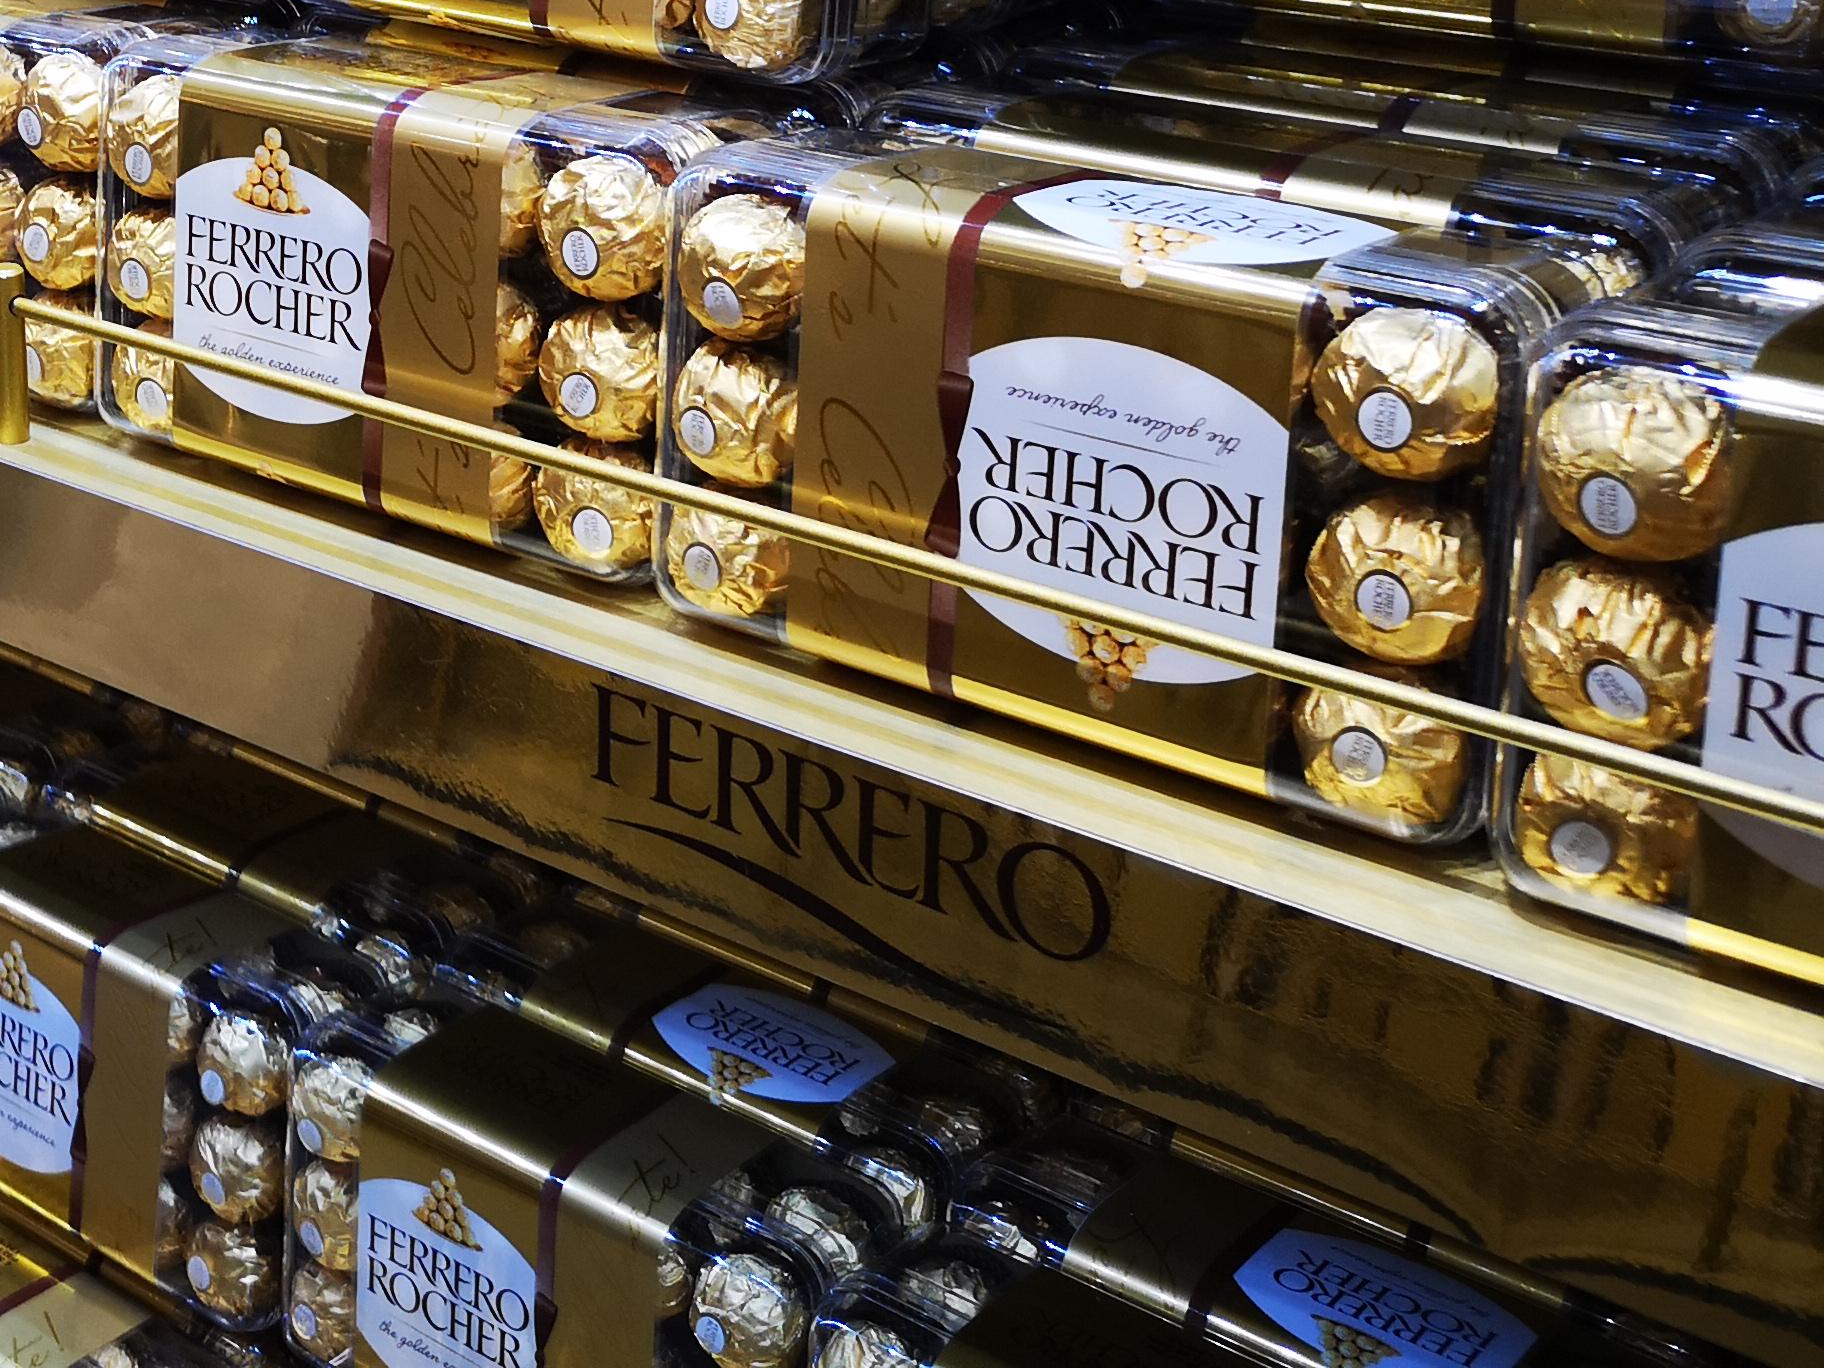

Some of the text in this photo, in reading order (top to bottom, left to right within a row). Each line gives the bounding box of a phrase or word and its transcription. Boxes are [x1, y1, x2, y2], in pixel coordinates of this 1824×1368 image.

[186, 212, 361, 295] FERRERO
[184, 262, 361, 352] ROCHER
[1006, 383, 1241, 456] the golden experience
[972, 426, 1264, 556] ROCHER
[968, 495, 1258, 621] FERRERO
[591, 681, 1112, 961] FERRERO
[686, 1009, 841, 1087] FERRERO
[713, 998, 864, 1070] ROCHER
[367, 1213, 530, 1332] FERRERO
[367, 1256, 522, 1368] ROCHER
[1273, 1267, 1486, 1368] FERRERO
[1297, 1249, 1499, 1350] ROCHER
[379, 1319, 442, 1366] the golden
